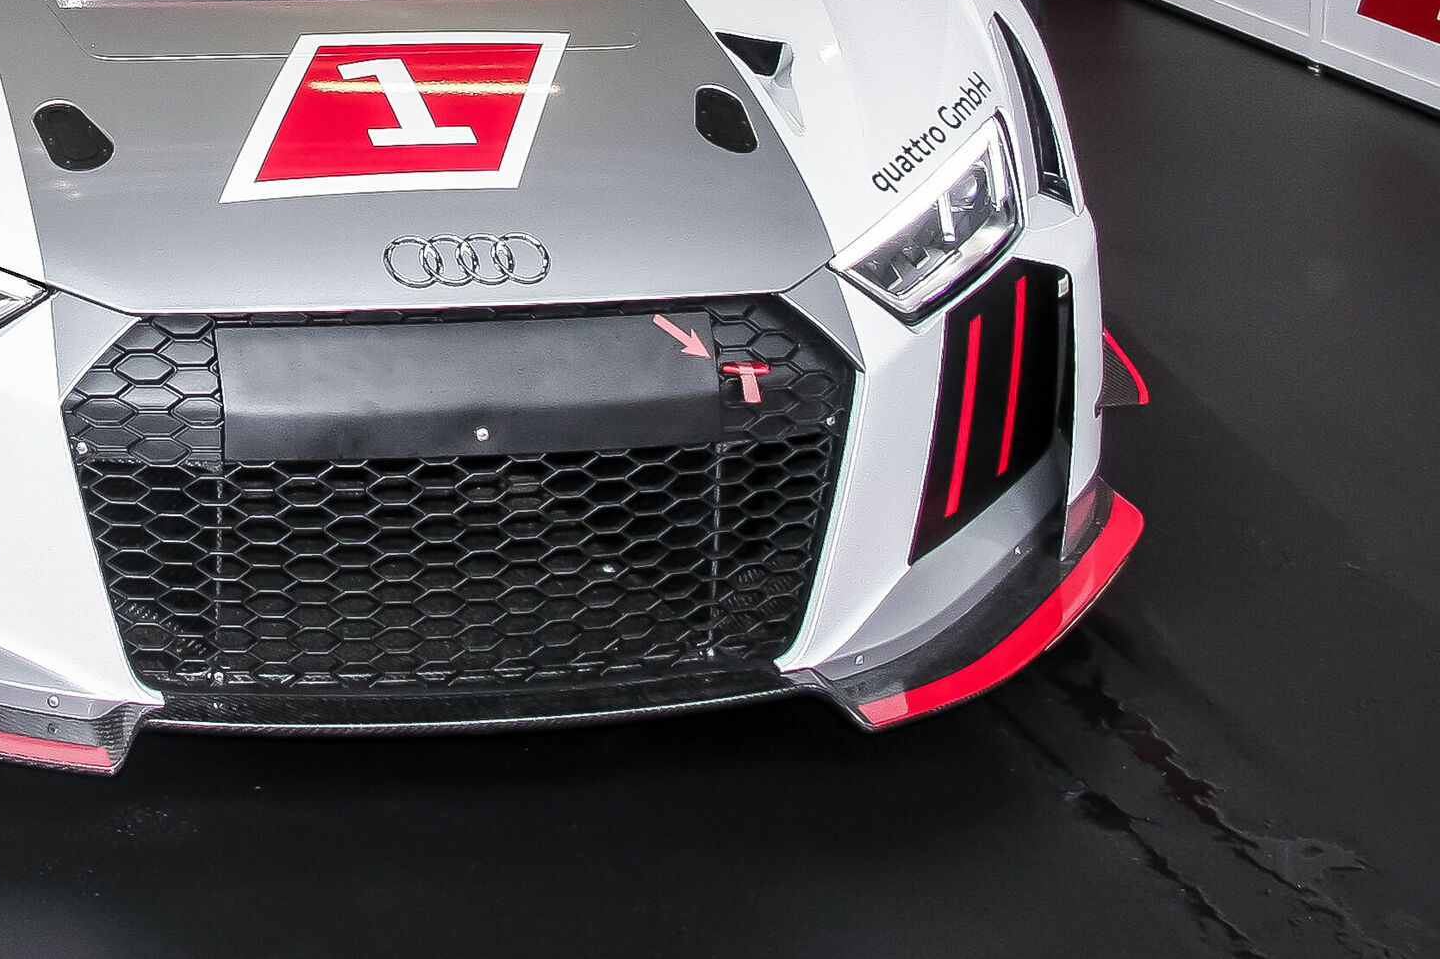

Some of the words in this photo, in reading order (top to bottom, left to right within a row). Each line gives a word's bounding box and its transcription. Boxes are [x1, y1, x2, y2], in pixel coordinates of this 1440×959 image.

[336, 57, 479, 147] 1
[871, 126, 947, 193] quattro
[937, 71, 992, 129] GmbH
